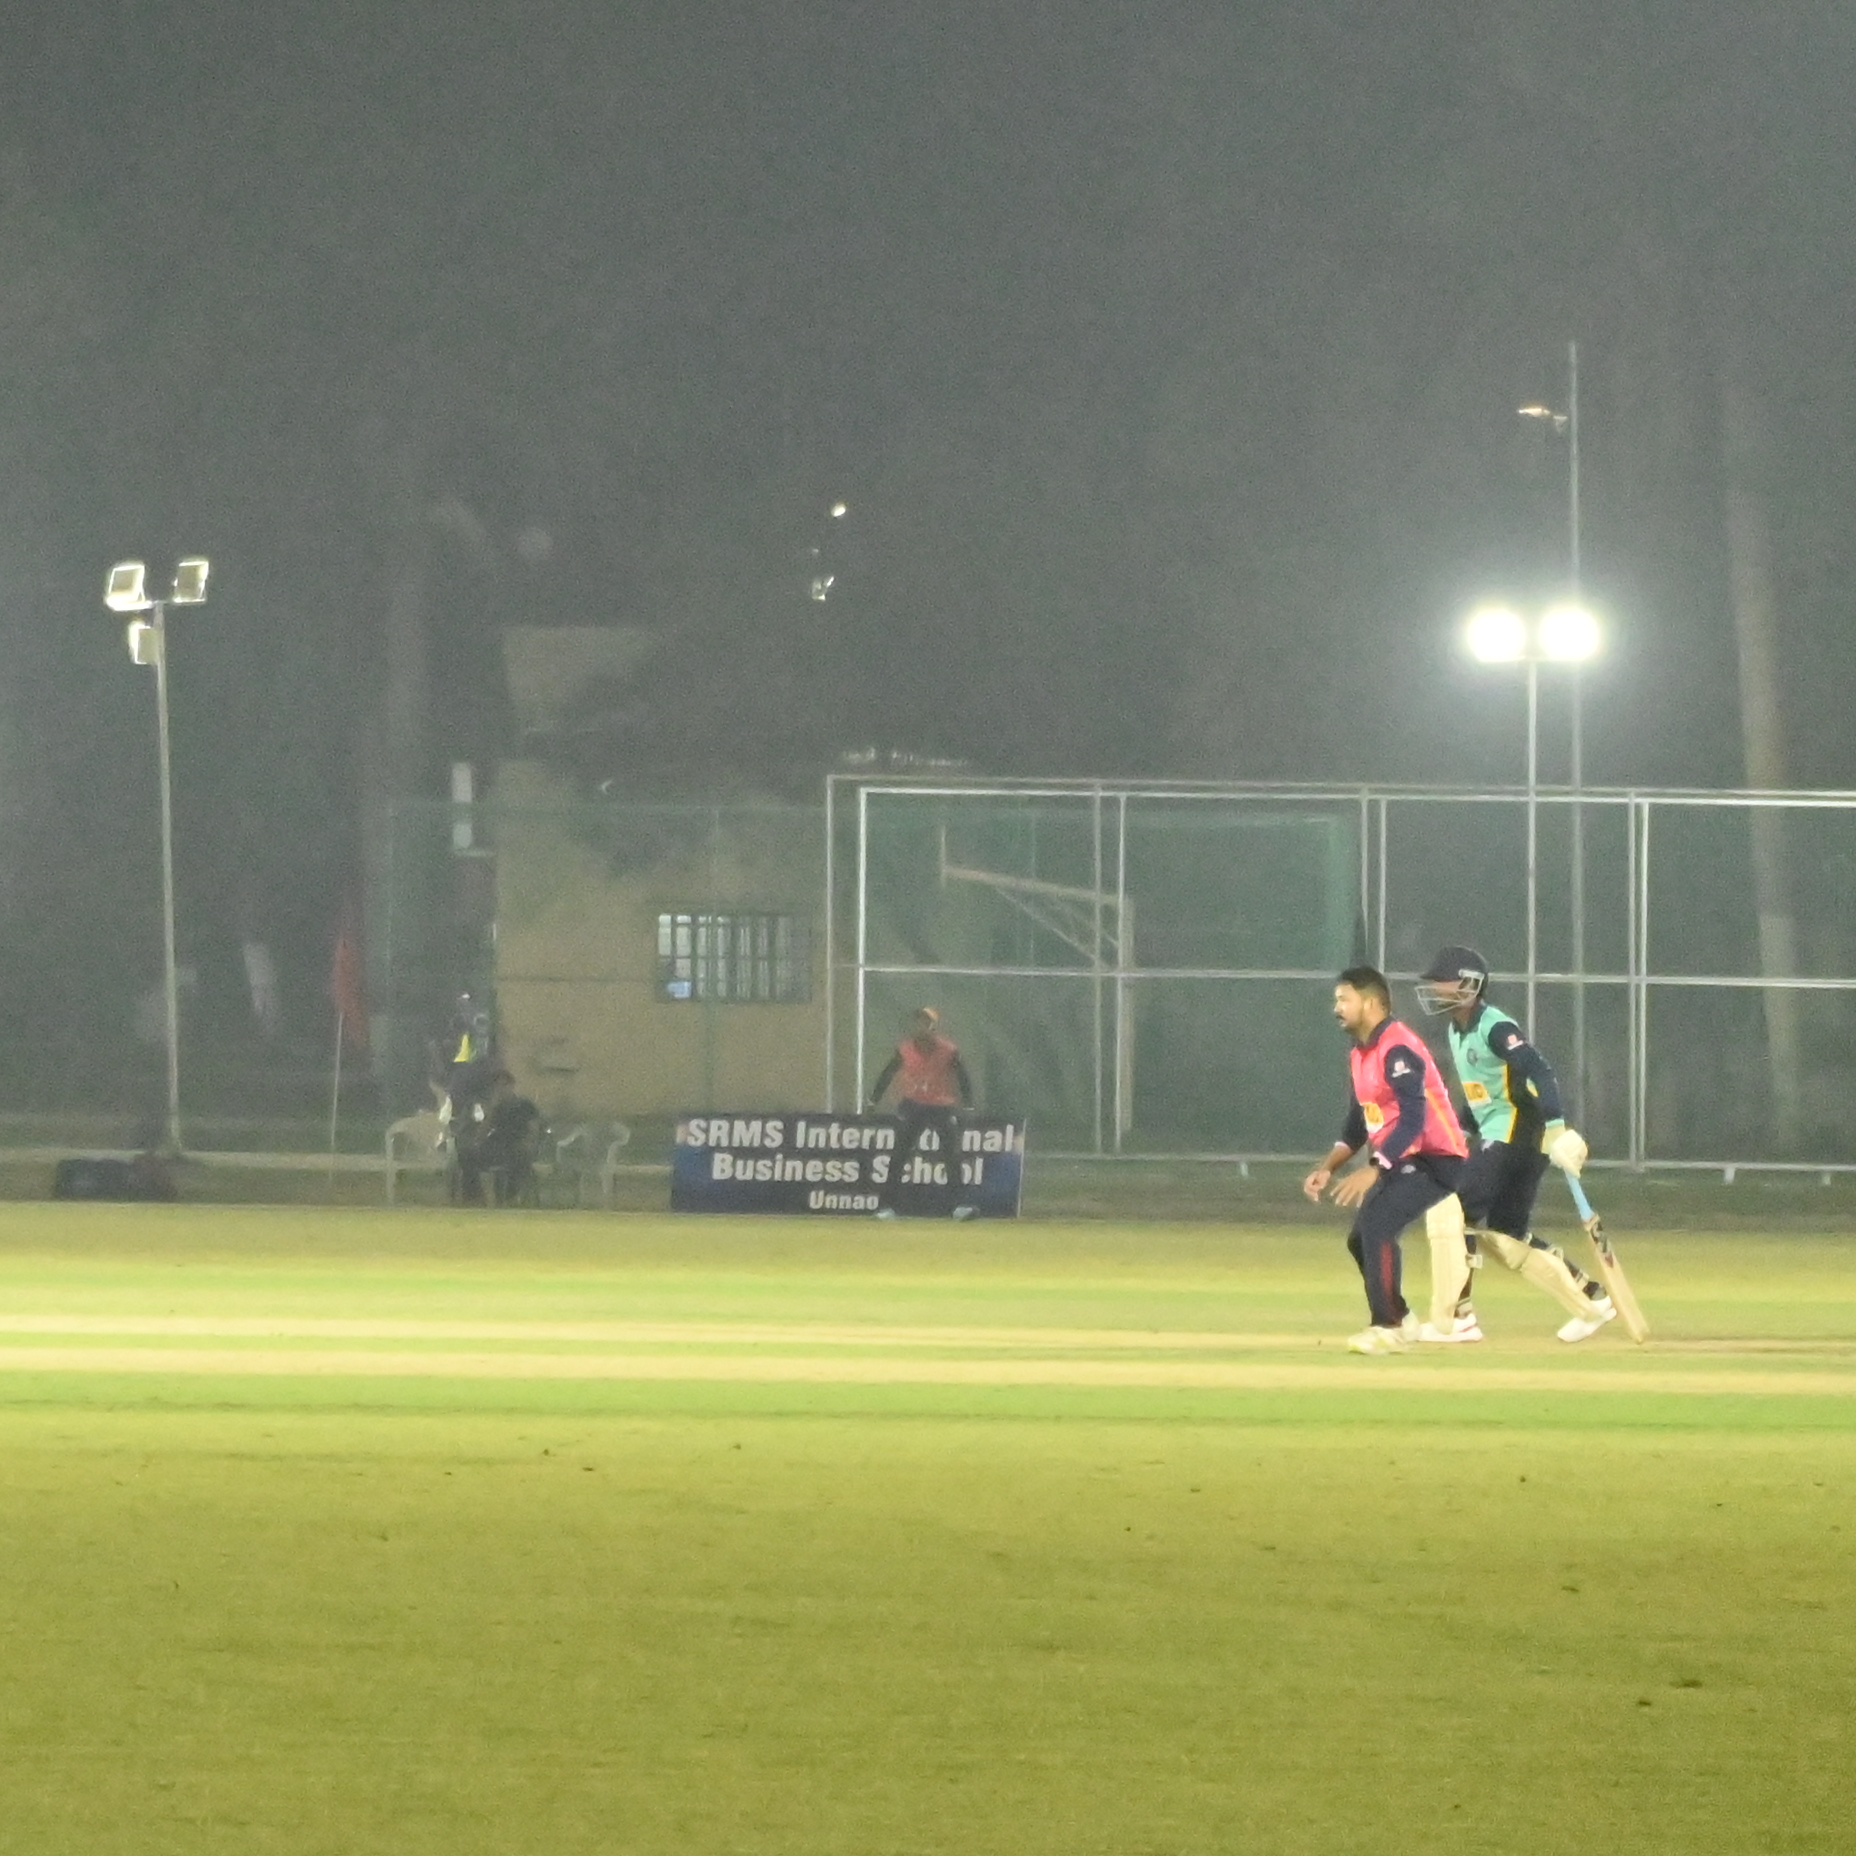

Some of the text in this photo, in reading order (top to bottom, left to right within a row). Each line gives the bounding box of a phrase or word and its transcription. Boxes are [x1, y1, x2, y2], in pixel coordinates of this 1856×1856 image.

[687, 1118, 784, 1148] SRMS
[712, 1152, 860, 1182] Business
[808, 1190, 879, 1211] Unnao
